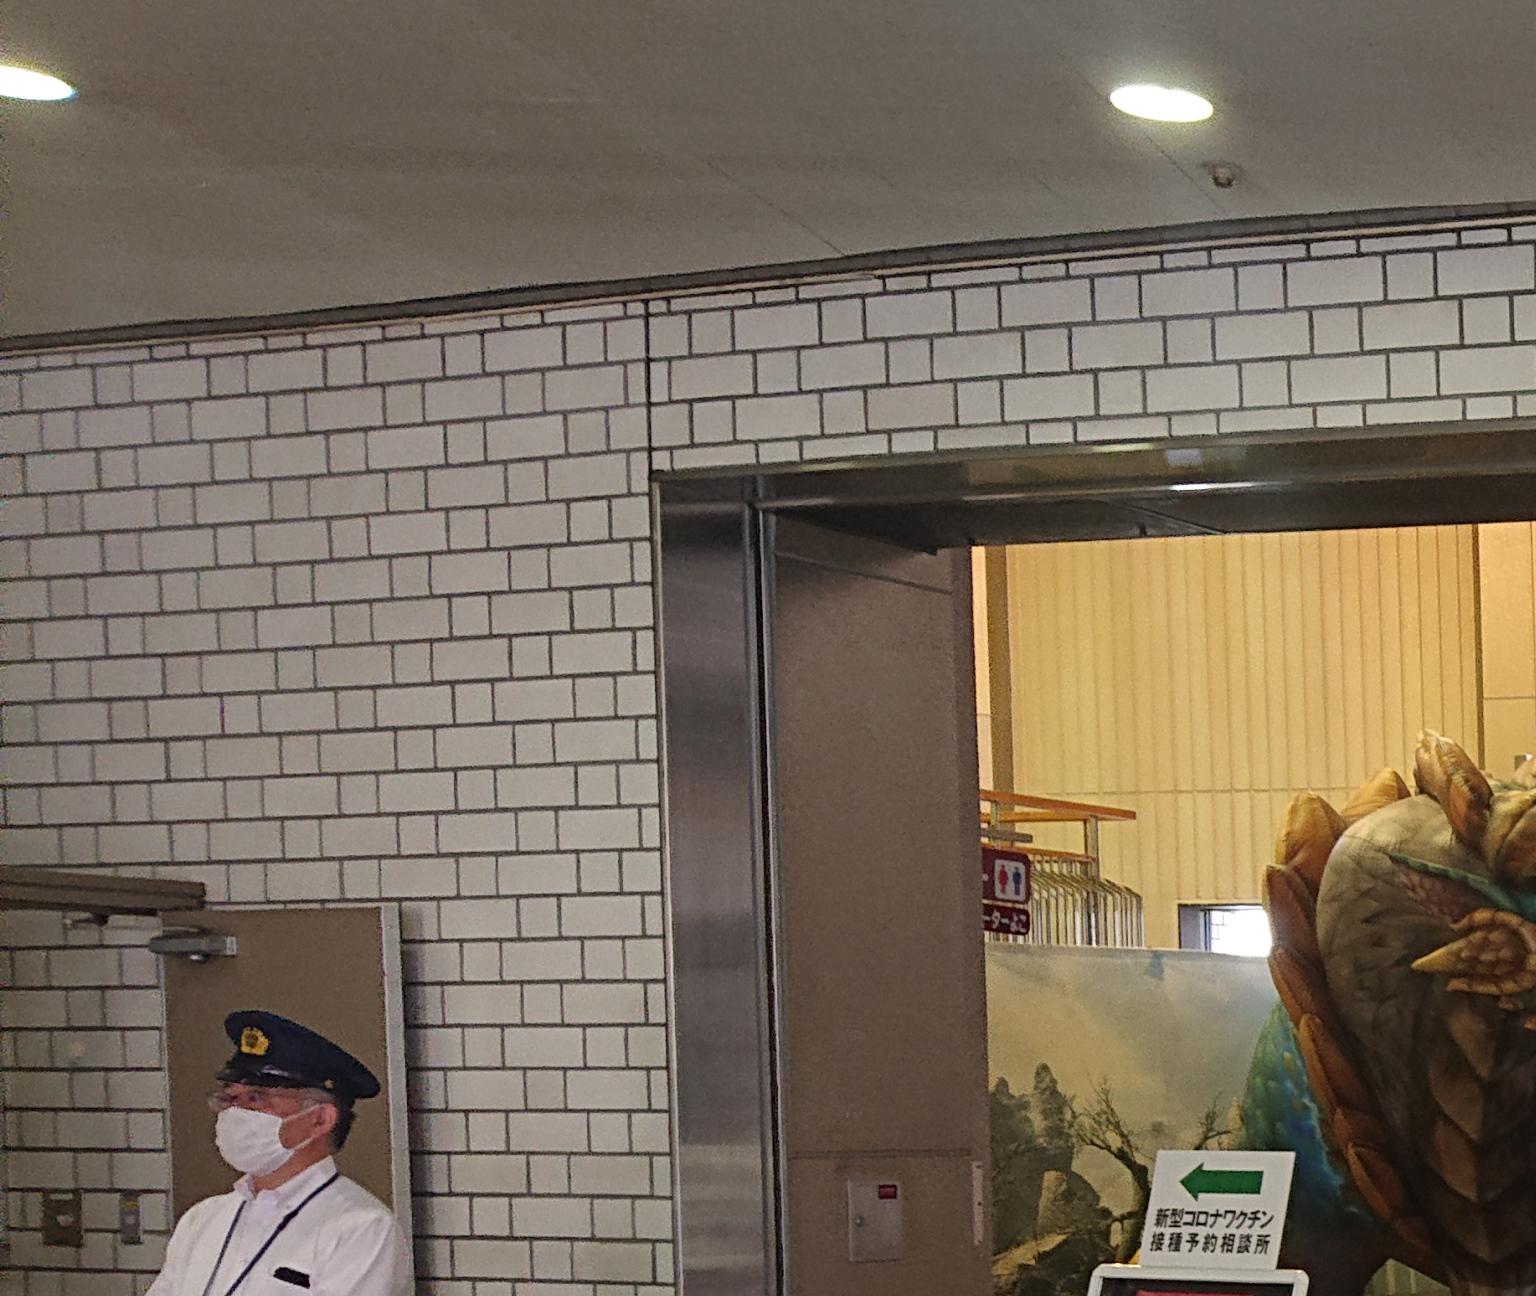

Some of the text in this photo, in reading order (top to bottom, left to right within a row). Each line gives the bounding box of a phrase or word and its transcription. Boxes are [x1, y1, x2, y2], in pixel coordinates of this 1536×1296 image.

[1155, 1208, 1274, 1229] 新型コロナワクチン
[1149, 1231, 1271, 1255] 接種予約相談所
